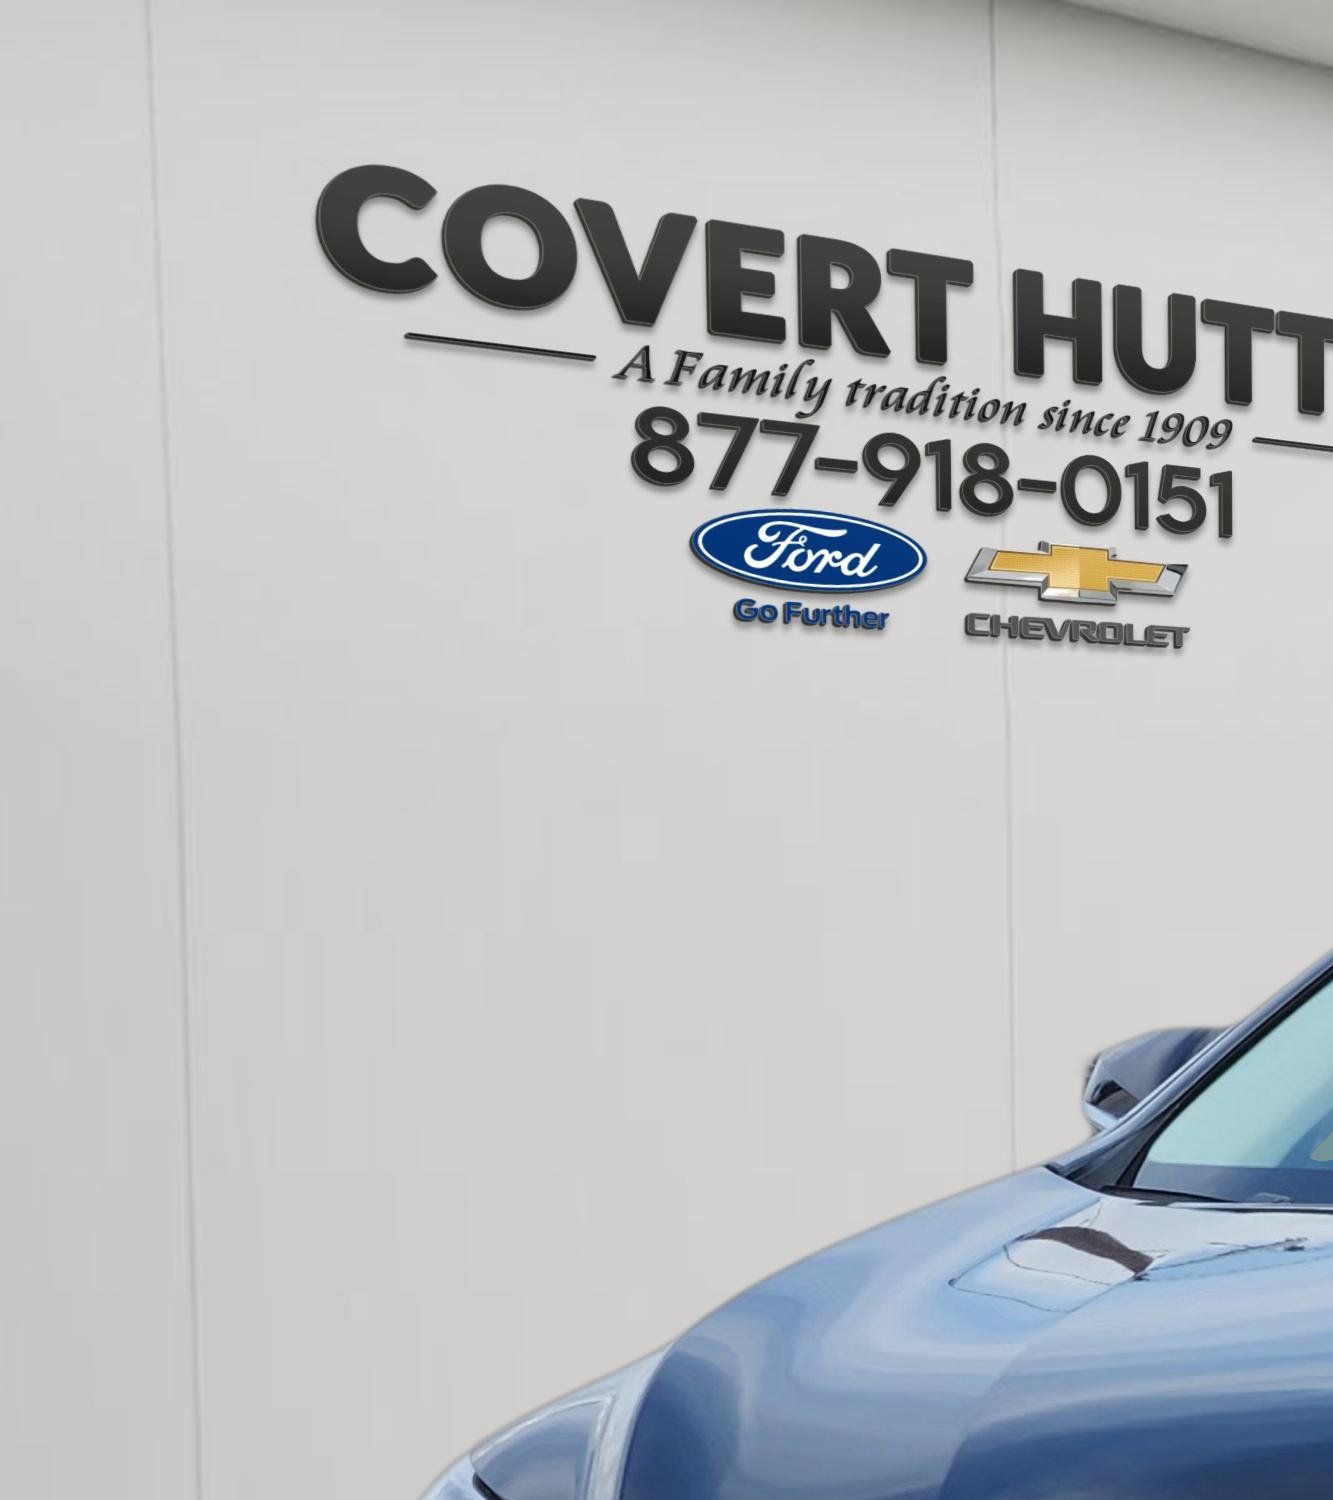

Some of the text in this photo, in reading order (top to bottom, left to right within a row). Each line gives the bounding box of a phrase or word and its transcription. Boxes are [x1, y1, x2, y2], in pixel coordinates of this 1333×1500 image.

[315, 164, 974, 367] COVERT
[612, 345, 1233, 450] A Family tradition since 1909
[630, 406, 1233, 540] 877-918-0151
[743, 519, 882, 578] Ford
[733, 598, 890, 631] Go Further
[964, 612, 1190, 650] CHEVROLET
